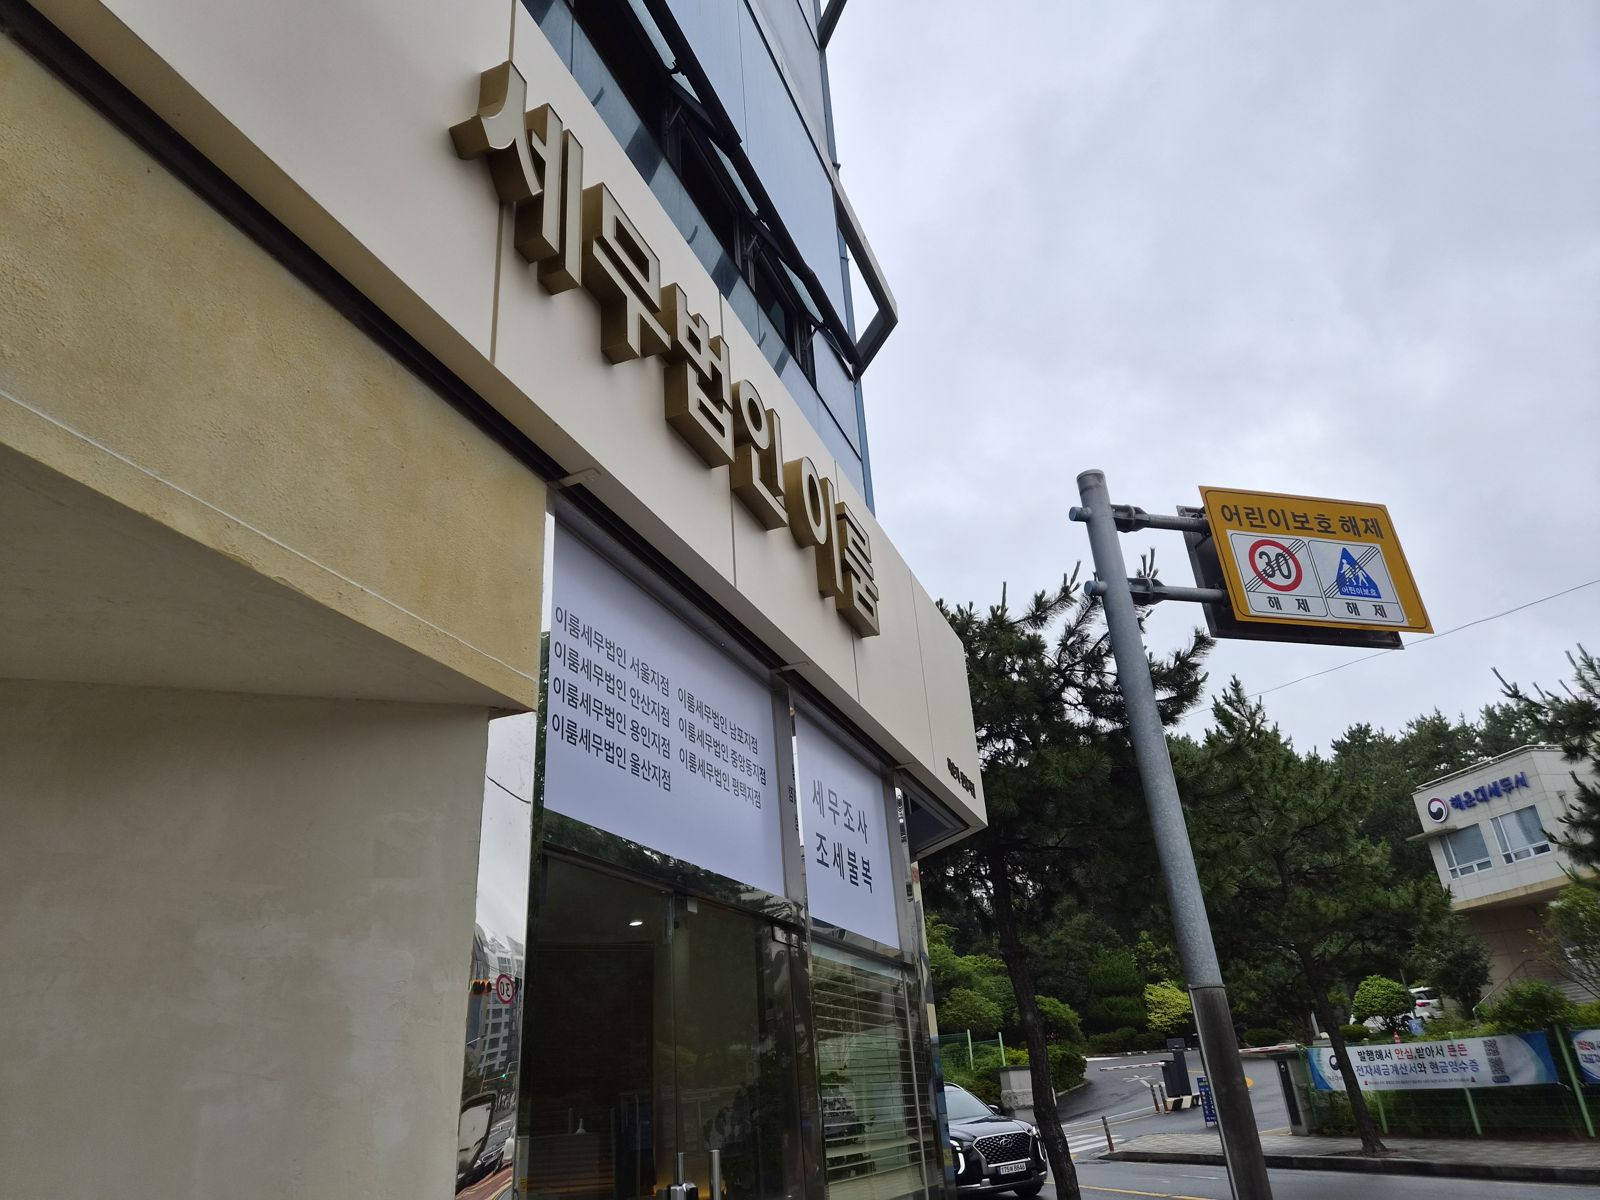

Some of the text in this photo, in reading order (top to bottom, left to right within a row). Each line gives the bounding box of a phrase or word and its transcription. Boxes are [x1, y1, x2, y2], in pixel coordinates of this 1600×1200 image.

[455, 61, 880, 638] 세무법인 이룸
[1258, 550, 1292, 580] 30
[1341, 586, 1378, 596] 어린이보호
[554, 640, 670, 728] 이룸세무법인 안산지점
[555, 606, 670, 698] 이룸세무법인 서울지점
[553, 676, 671, 760] 이룸세무법인 용인지점
[677, 687, 759, 755] 이룸세무법인 남포지점
[678, 716, 767, 786] 이룸세무법인 중앙동지점
[551, 713, 671, 792] 이룸세무법인 울산지점
[679, 747, 730, 793] 이룸세무법인
[732, 777, 762, 810] 평택지점
[812, 779, 869, 845] 세무조사
[815, 831, 874, 894] 조세불복
[1355, 1058, 1479, 1076] 전자세금계산서와 현금영수증
[1357, 1049, 1393, 1062] 발행해서
